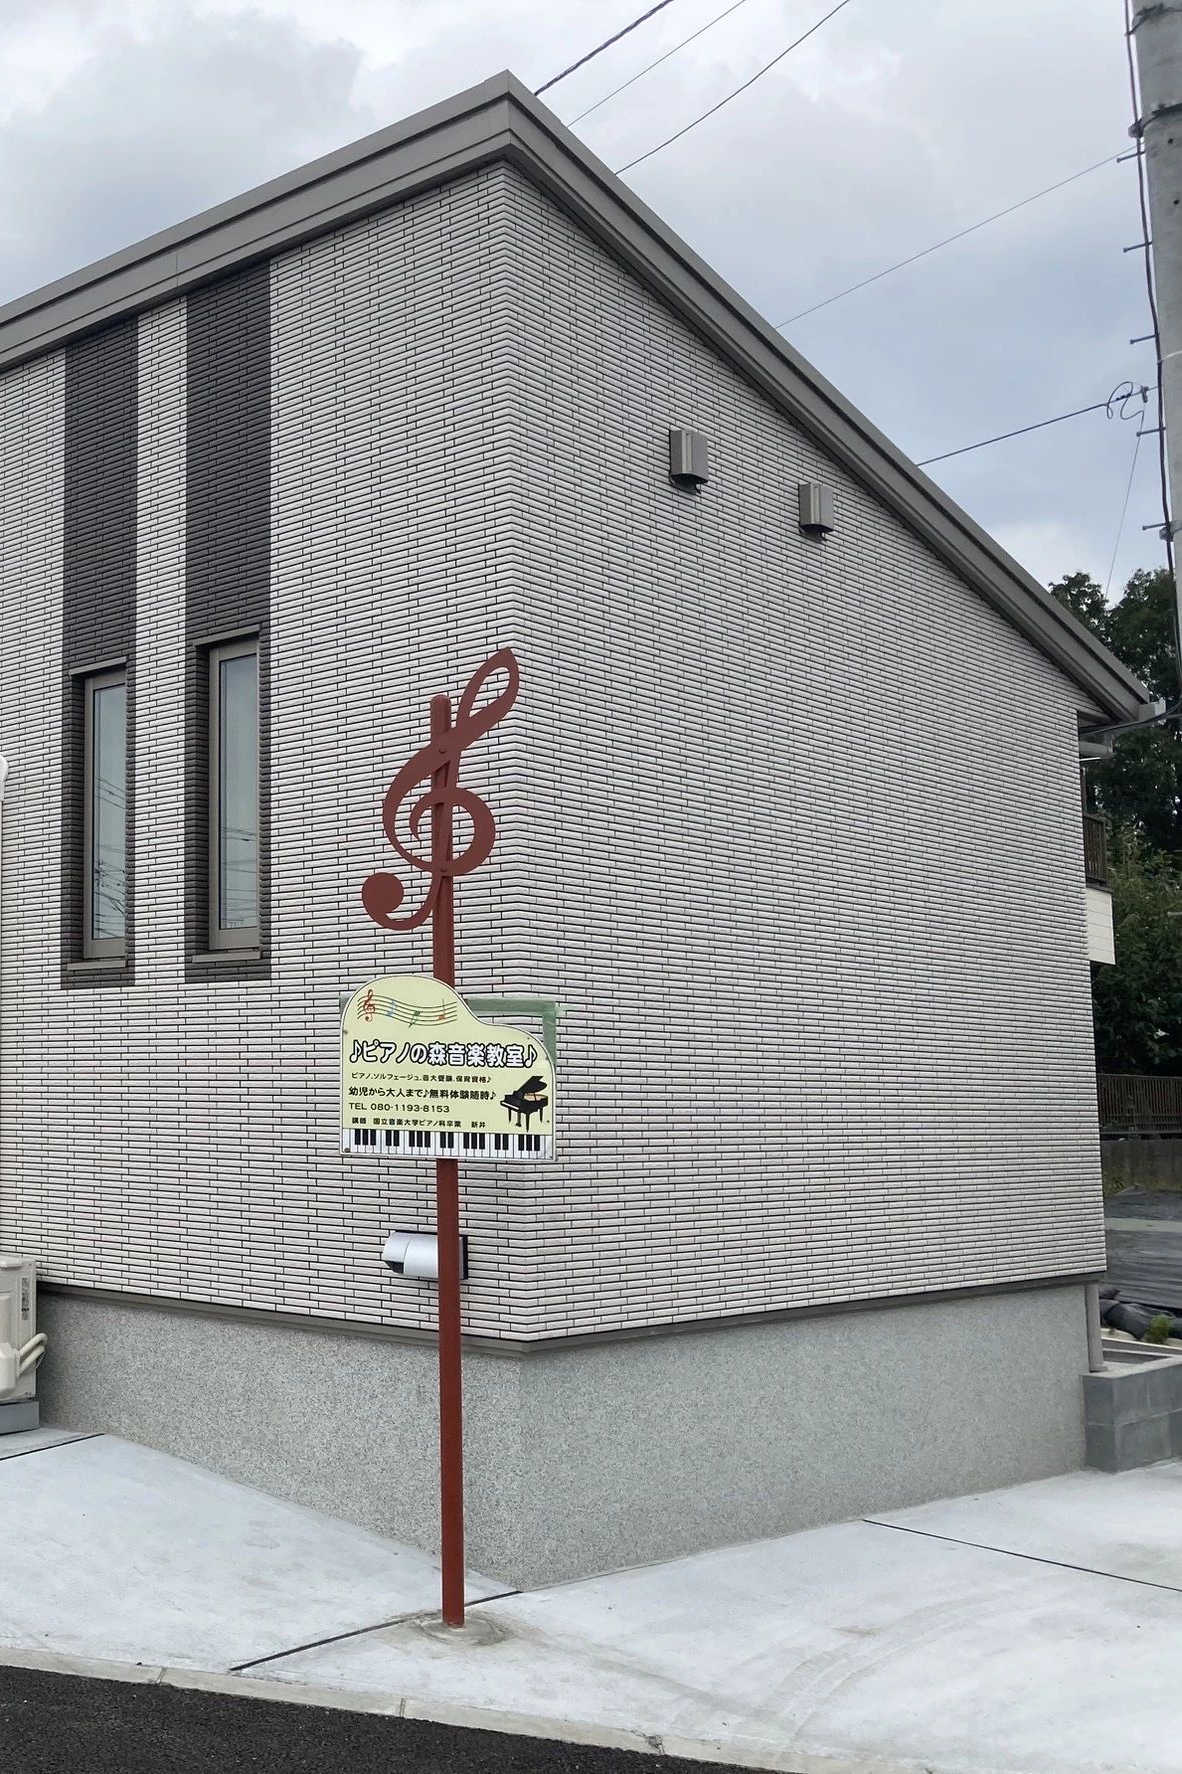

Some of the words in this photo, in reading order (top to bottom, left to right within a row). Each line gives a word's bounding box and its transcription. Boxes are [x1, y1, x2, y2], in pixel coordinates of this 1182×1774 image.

[361, 1039, 524, 1068] ピアノの森音楽教室
[349, 1102, 367, 1111] TEL
